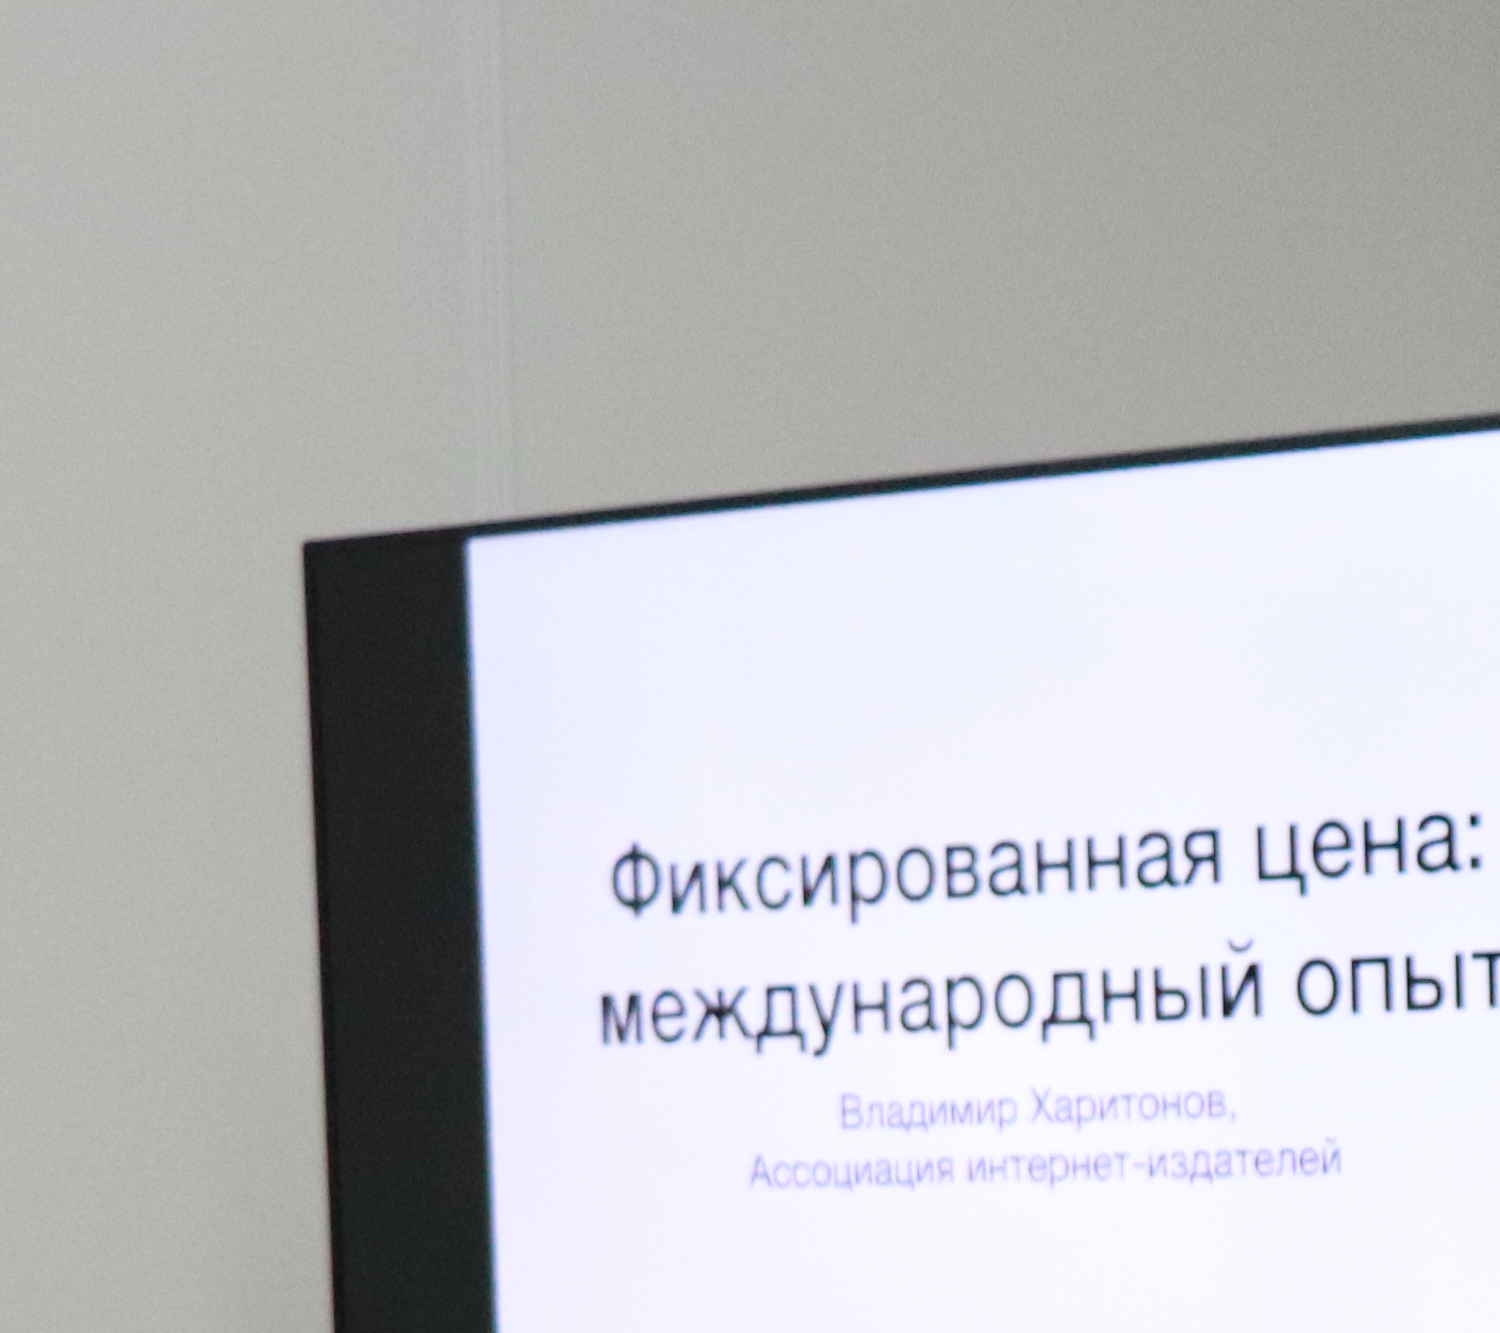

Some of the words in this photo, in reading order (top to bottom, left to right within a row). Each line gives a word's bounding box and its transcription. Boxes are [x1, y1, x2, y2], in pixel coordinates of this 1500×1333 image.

[610, 823, 1222, 924] Фиксированная
[1254, 812, 1483, 896] цена:
[599, 939, 1264, 1056] международный
[840, 1092, 1018, 1136] Владимир
[1030, 1087, 1238, 1131] Харитонов,
[749, 1153, 955, 1191] Ассоциация
[966, 1135, 1343, 1190] интернет-издателей
